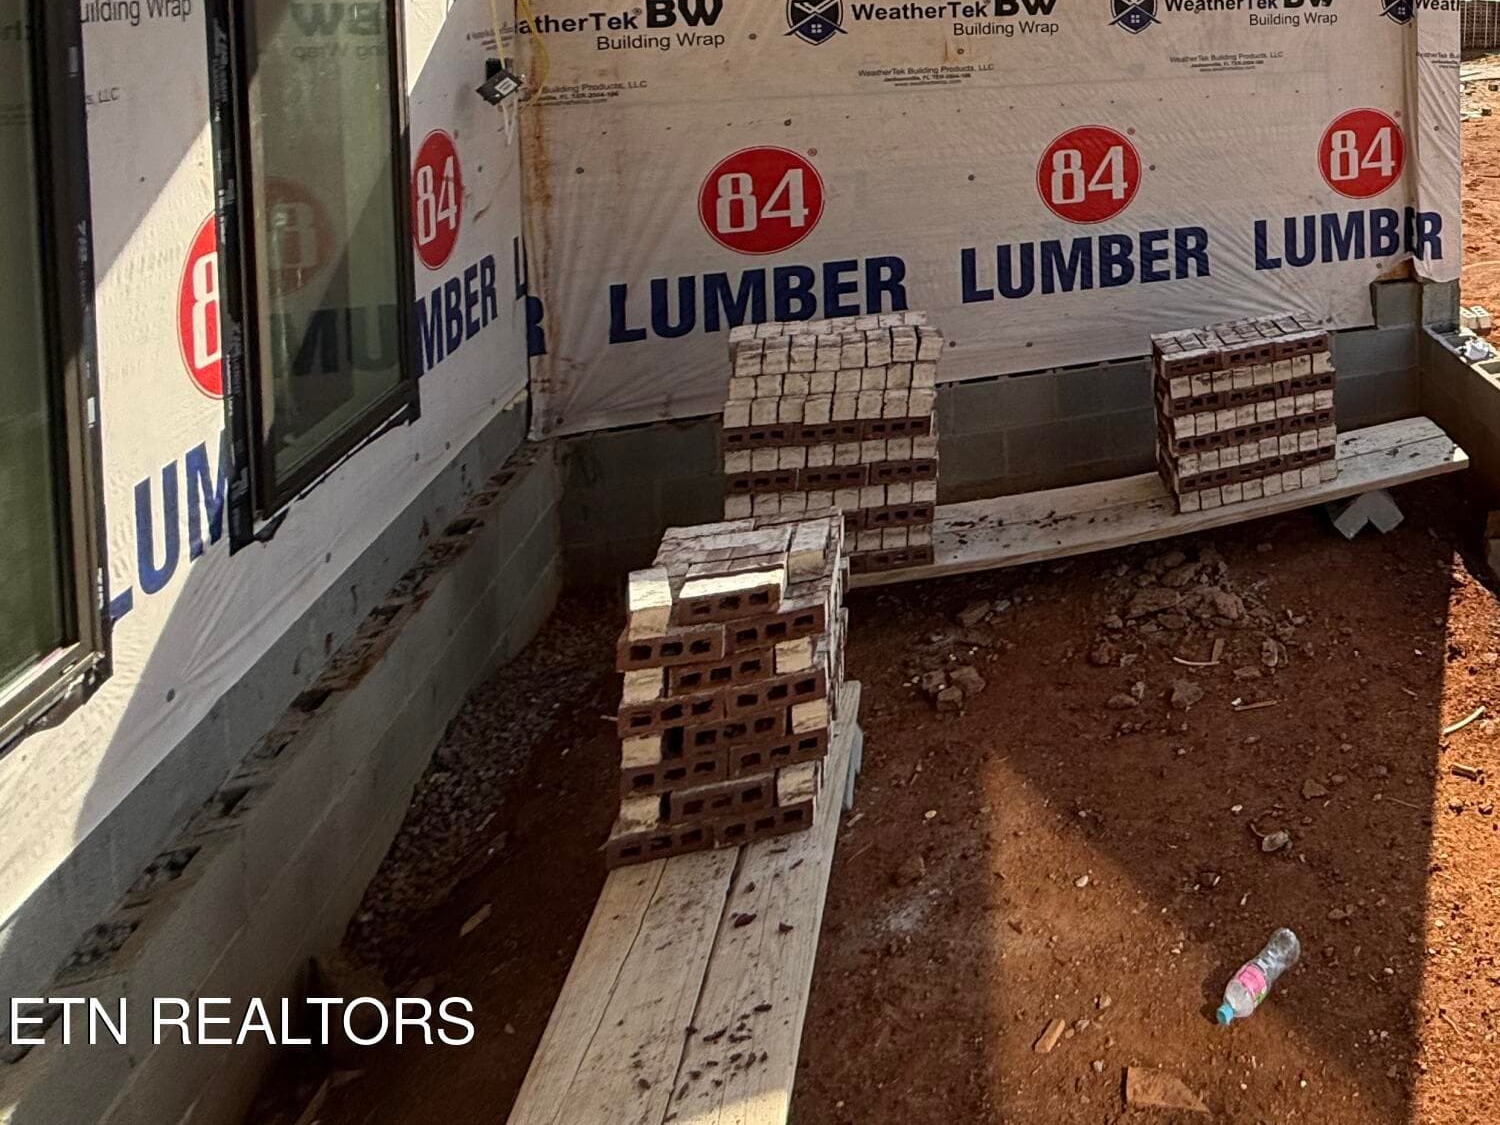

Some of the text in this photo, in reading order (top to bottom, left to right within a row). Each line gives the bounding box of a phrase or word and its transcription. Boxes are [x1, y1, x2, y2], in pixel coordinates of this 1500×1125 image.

[597, 32, 725, 51] Building Wrap
[953, 20, 1059, 37] Building Wrap
[1249, 12, 1338, 27] Building Wrap
[417, 155, 458, 247] 84
[716, 126, 1397, 234] 84 84 84
[609, 255, 909, 345] LUMBER
[961, 226, 1211, 304] LUMBER
[1254, 205, 1444, 271] LUMBER
